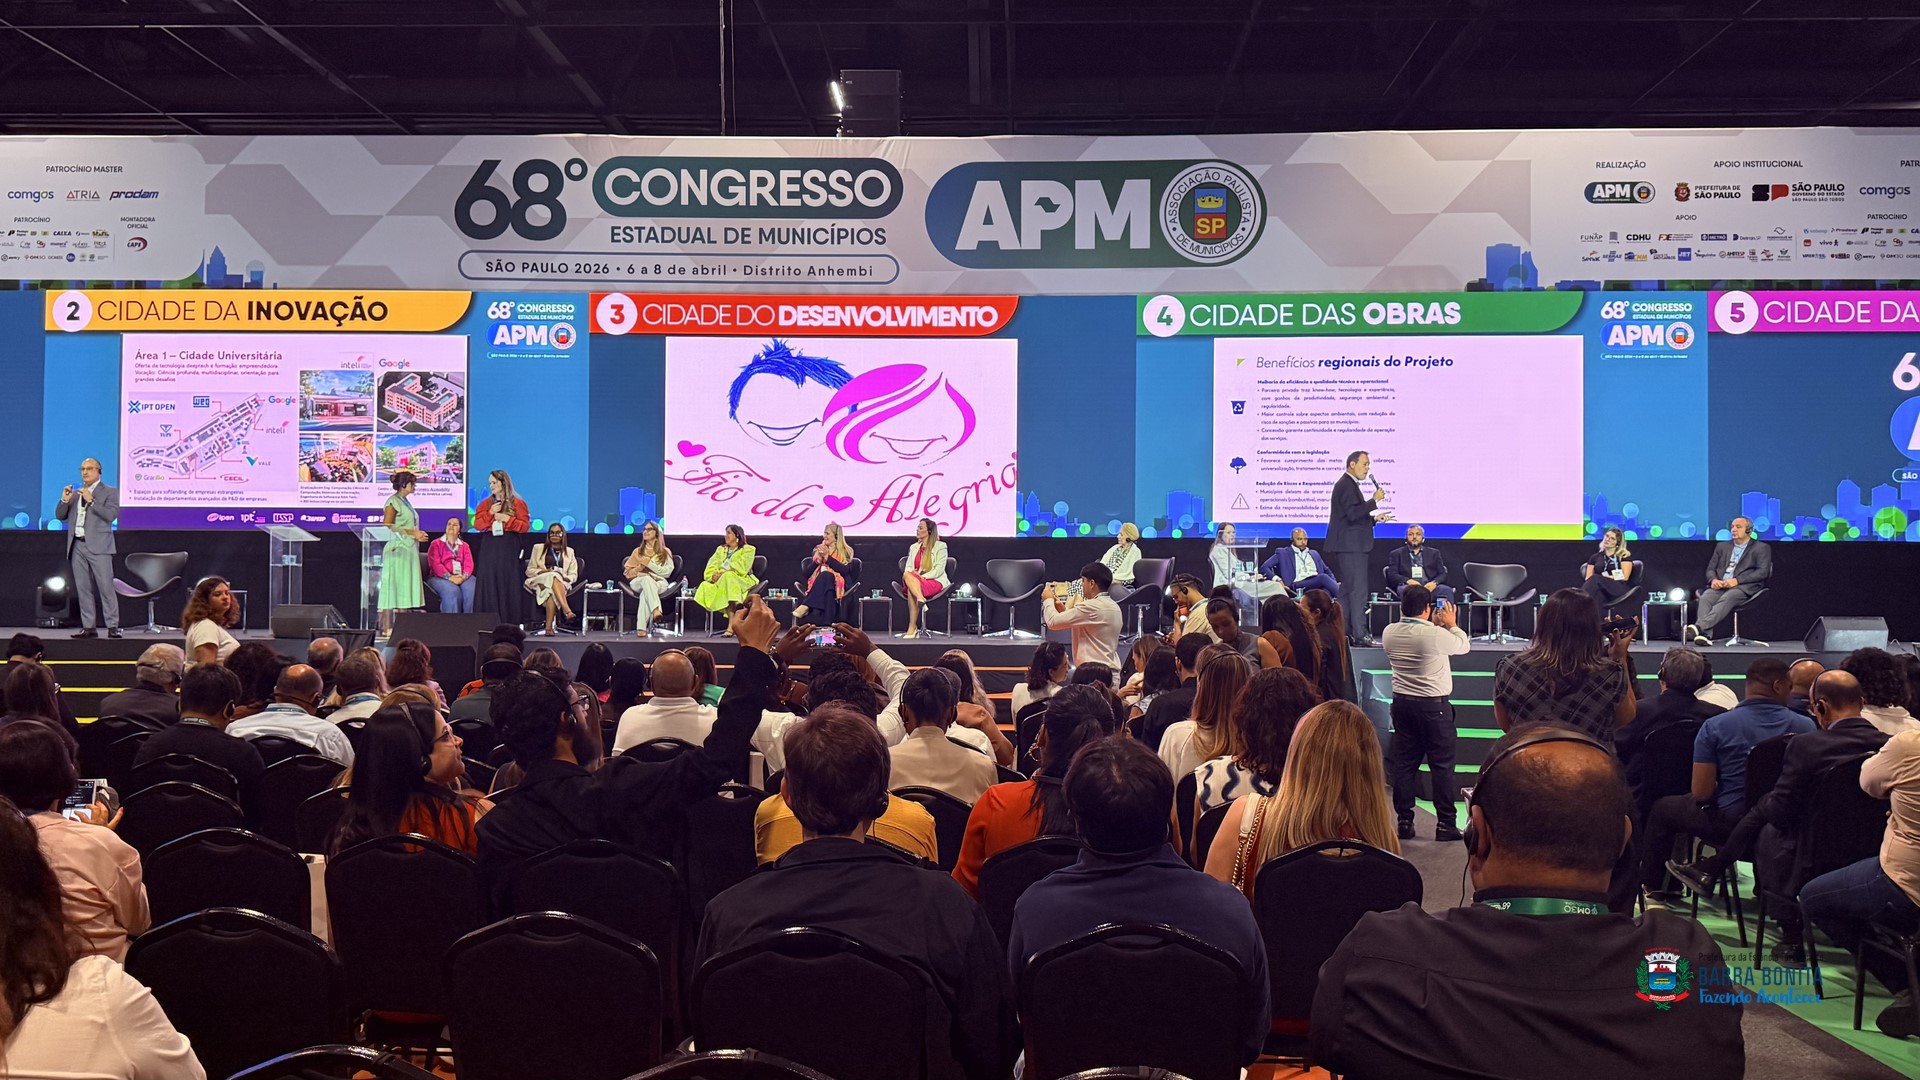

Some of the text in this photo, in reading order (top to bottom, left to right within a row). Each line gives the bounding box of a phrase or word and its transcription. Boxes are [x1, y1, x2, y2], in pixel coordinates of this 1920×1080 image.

[46, 164, 92, 173] PATROCÍNIO
[1596, 160, 1646, 170] REALIZAÇÃO
[109, 189, 159, 200] prodam
[604, 168, 892, 207] CONGRESSO
[1593, 184, 1630, 198] APM
[1792, 182, 1812, 191] SÃO
[1860, 186, 1910, 199] comgas
[7, 190, 54, 203] comgas
[1168, 170, 1252, 224] ASSOCIAÇÃO PAULISTA
[1695, 191, 1712, 199] SÃO
[955, 179, 1150, 250] APM
[610, 222, 887, 246] ESTADUAL DE MUNICÍPIOS
[1197, 218, 1225, 234] SP
[1176, 233, 1190, 247] DE
[485, 260, 874, 277] SÃO PAULO 2026 6 a 8 de abril Distrito Anhembi
[66, 302, 80, 321] 2
[97, 297, 389, 327] CIDADE DA INOVAÇÃO
[517, 304, 575, 312] CONGRESSO
[609, 304, 625, 324] 3
[1190, 302, 1461, 327] CIDADE DAS OBRAS
[1632, 303, 1692, 312] CONGRESSO
[1730, 303, 1745, 323] 5
[1763, 300, 1871, 323] CIDADE
[642, 304, 998, 328] CIDADE DO DESENVOLVIMENTO
[1157, 306, 1173, 326] 4
[493, 325, 548, 345] APM
[1607, 325, 1664, 346] APM
[135, 349, 282, 360] Área 1 Cidade Universitária
[1256, 355, 1454, 370] Benefícios regionais do Projeto
[379, 358, 410, 369] Google
[268, 396, 296, 405] Google
[751, 484, 823, 522] da
